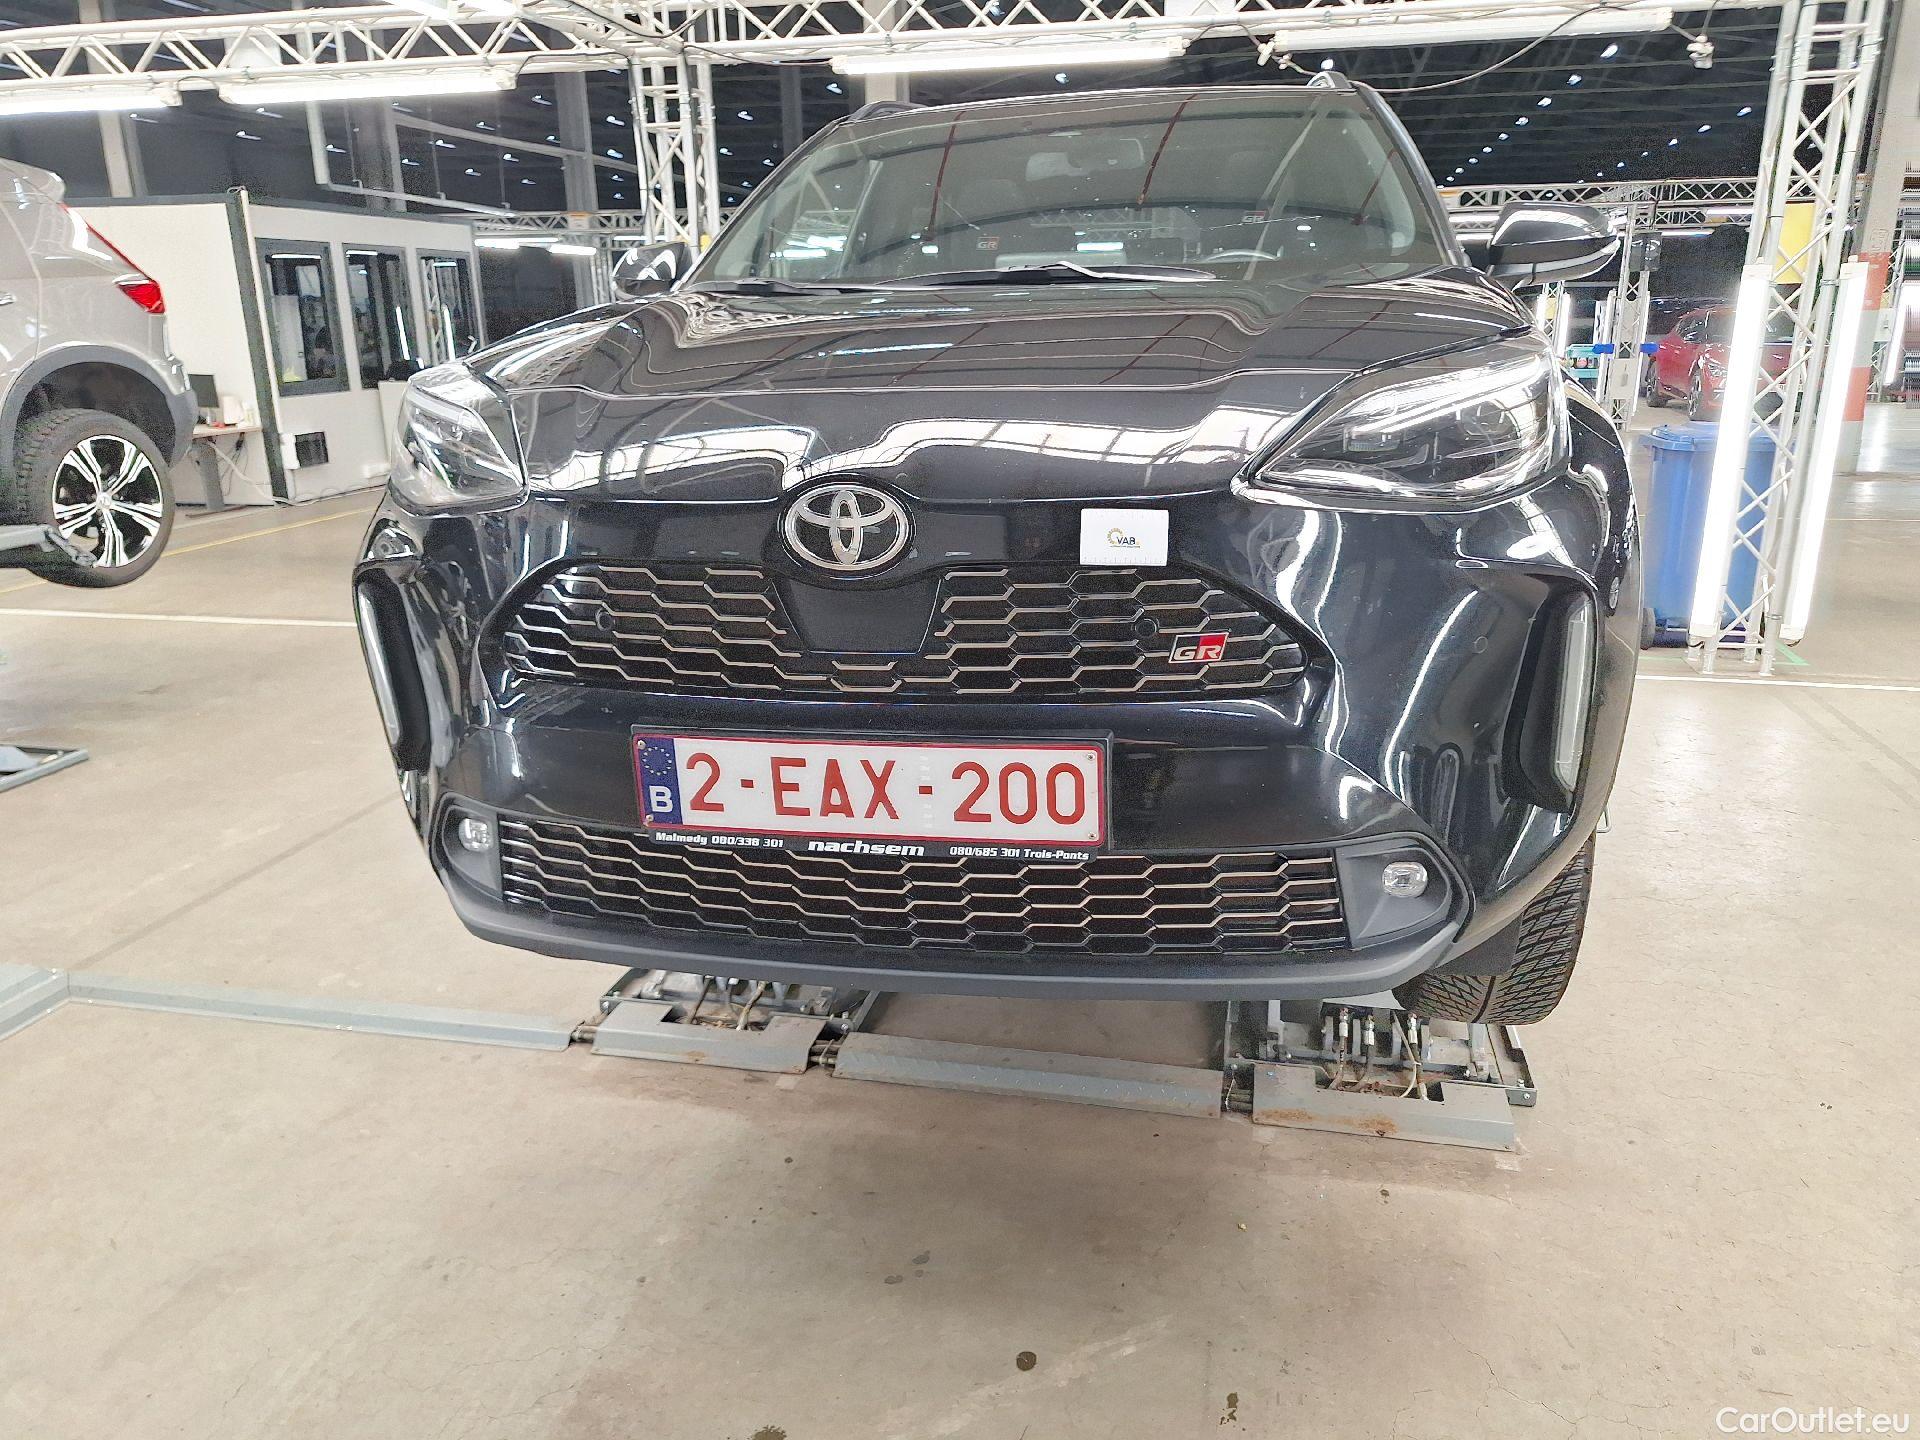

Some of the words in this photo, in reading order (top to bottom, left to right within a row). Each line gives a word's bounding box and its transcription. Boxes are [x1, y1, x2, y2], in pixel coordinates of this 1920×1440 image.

[1173, 645, 1222, 661] GR
[685, 751, 1086, 825] 2-EAX-200
[650, 786, 673, 813] B
[655, 831, 708, 846] Malmedy
[711, 835, 760, 848] 080/338
[762, 838, 784, 849] 301
[807, 840, 925, 857] nachsem
[949, 846, 998, 857] 080/685
[1000, 847, 1021, 858] 301
[1023, 848, 1090, 861] Trois-Ponts
